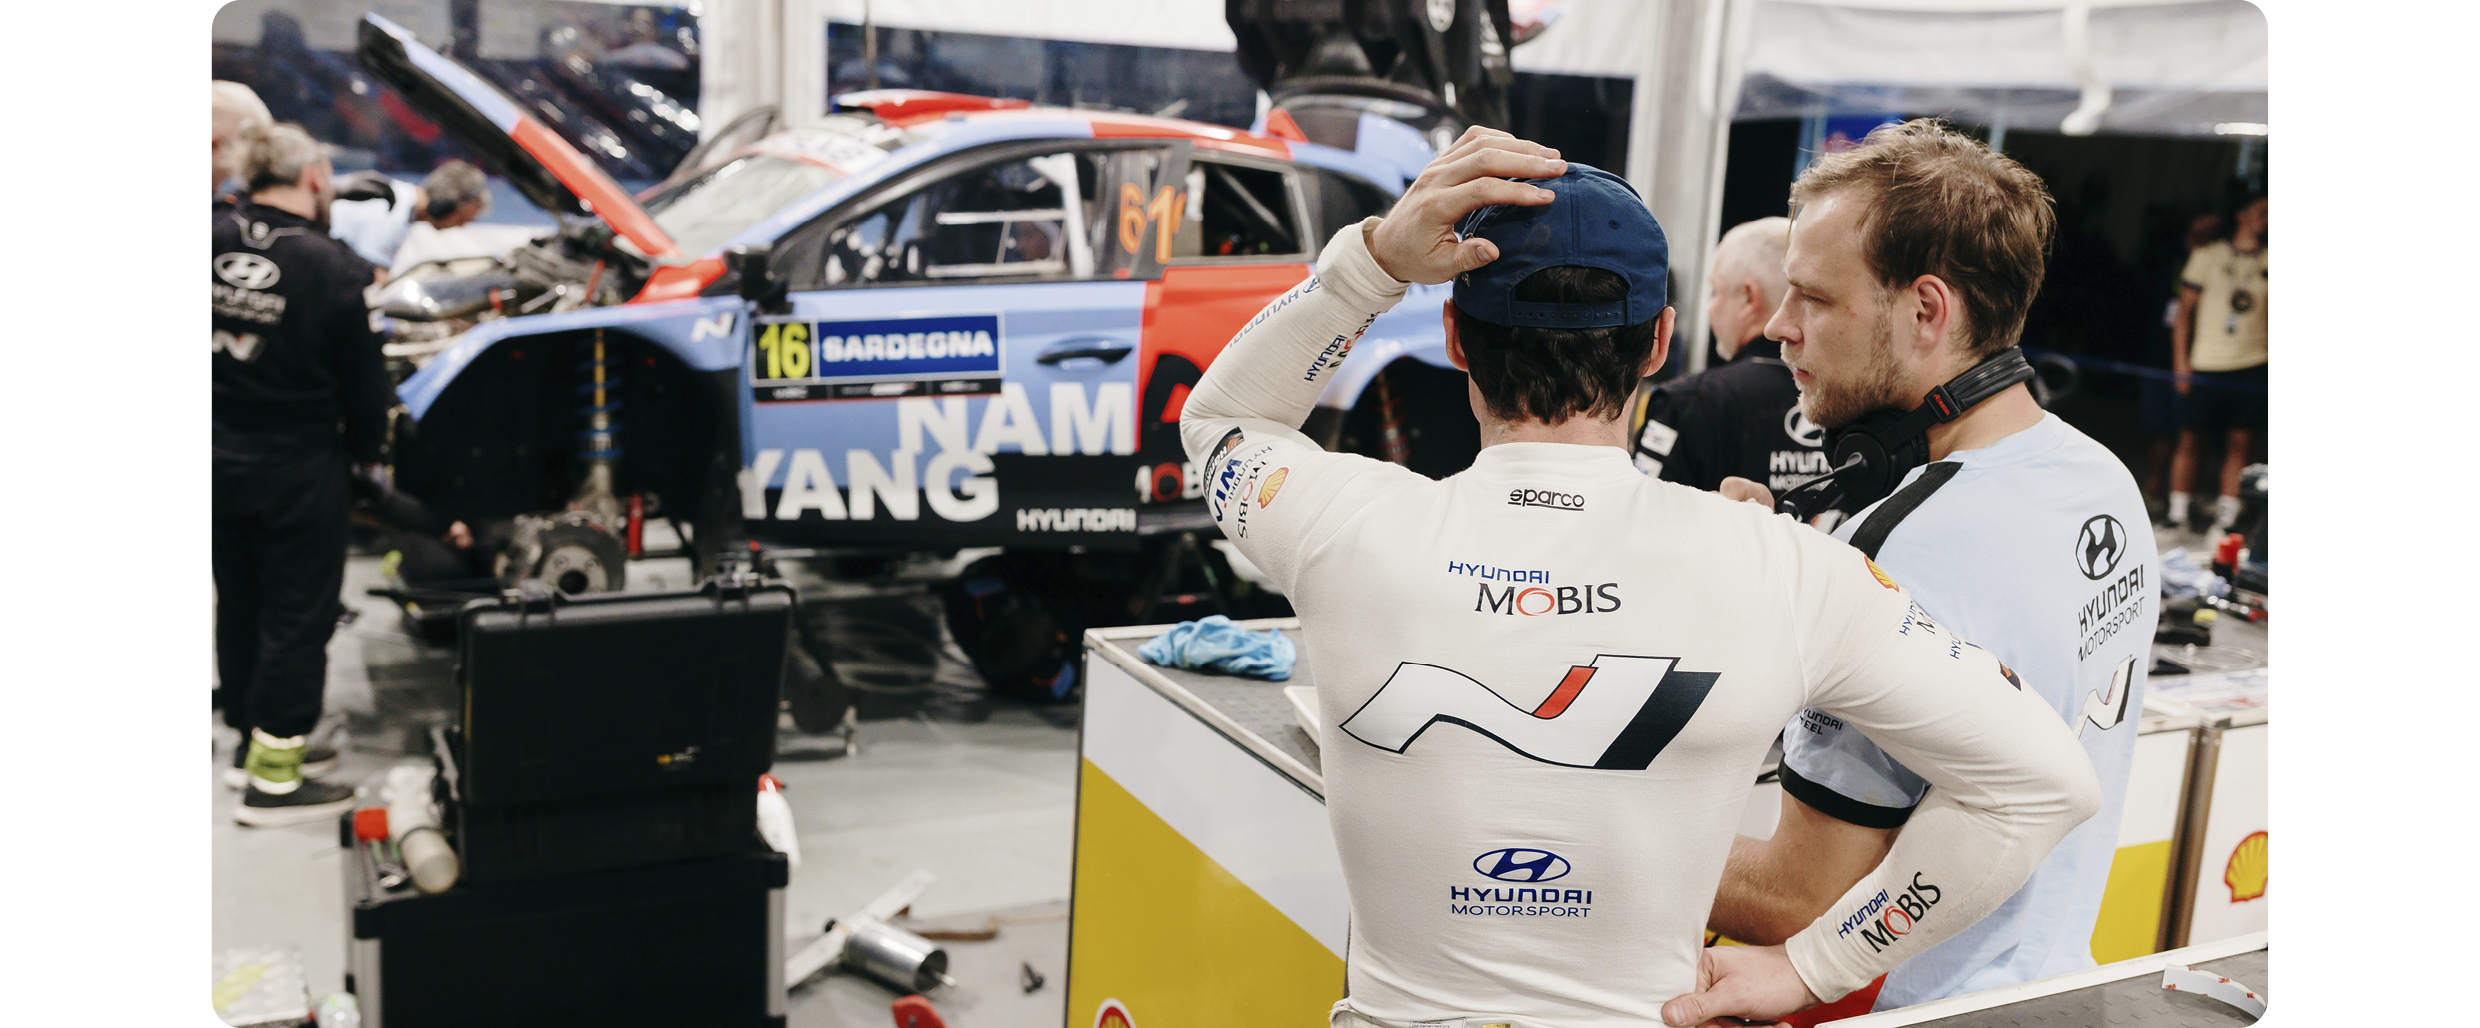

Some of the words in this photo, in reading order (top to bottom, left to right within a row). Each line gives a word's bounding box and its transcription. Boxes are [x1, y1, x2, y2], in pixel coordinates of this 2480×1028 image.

[759, 322, 811, 379] 16
[822, 330, 995, 363] SARDEGNA
[1304, 334, 1348, 382] HYUNDAI
[898, 382, 1133, 455] NAM
[738, 449, 999, 522] YANG
[1769, 451, 1829, 474] HYUN
[1017, 508, 1136, 532] HYUNDAI
[1508, 488, 1585, 511] sparco
[1448, 561, 1550, 584] HYUNDAI
[1474, 582, 1622, 616] MOBIS
[2077, 564, 2145, 638] HYUNDAI
[2078, 596, 2145, 662] MOTORSPORT
[1450, 885, 1592, 905] HYUNDAI
[1451, 904, 1592, 918] MOTORSPORT
[1837, 888, 1890, 939] HYUNDAI
[1860, 871, 1941, 954] MOBIS
